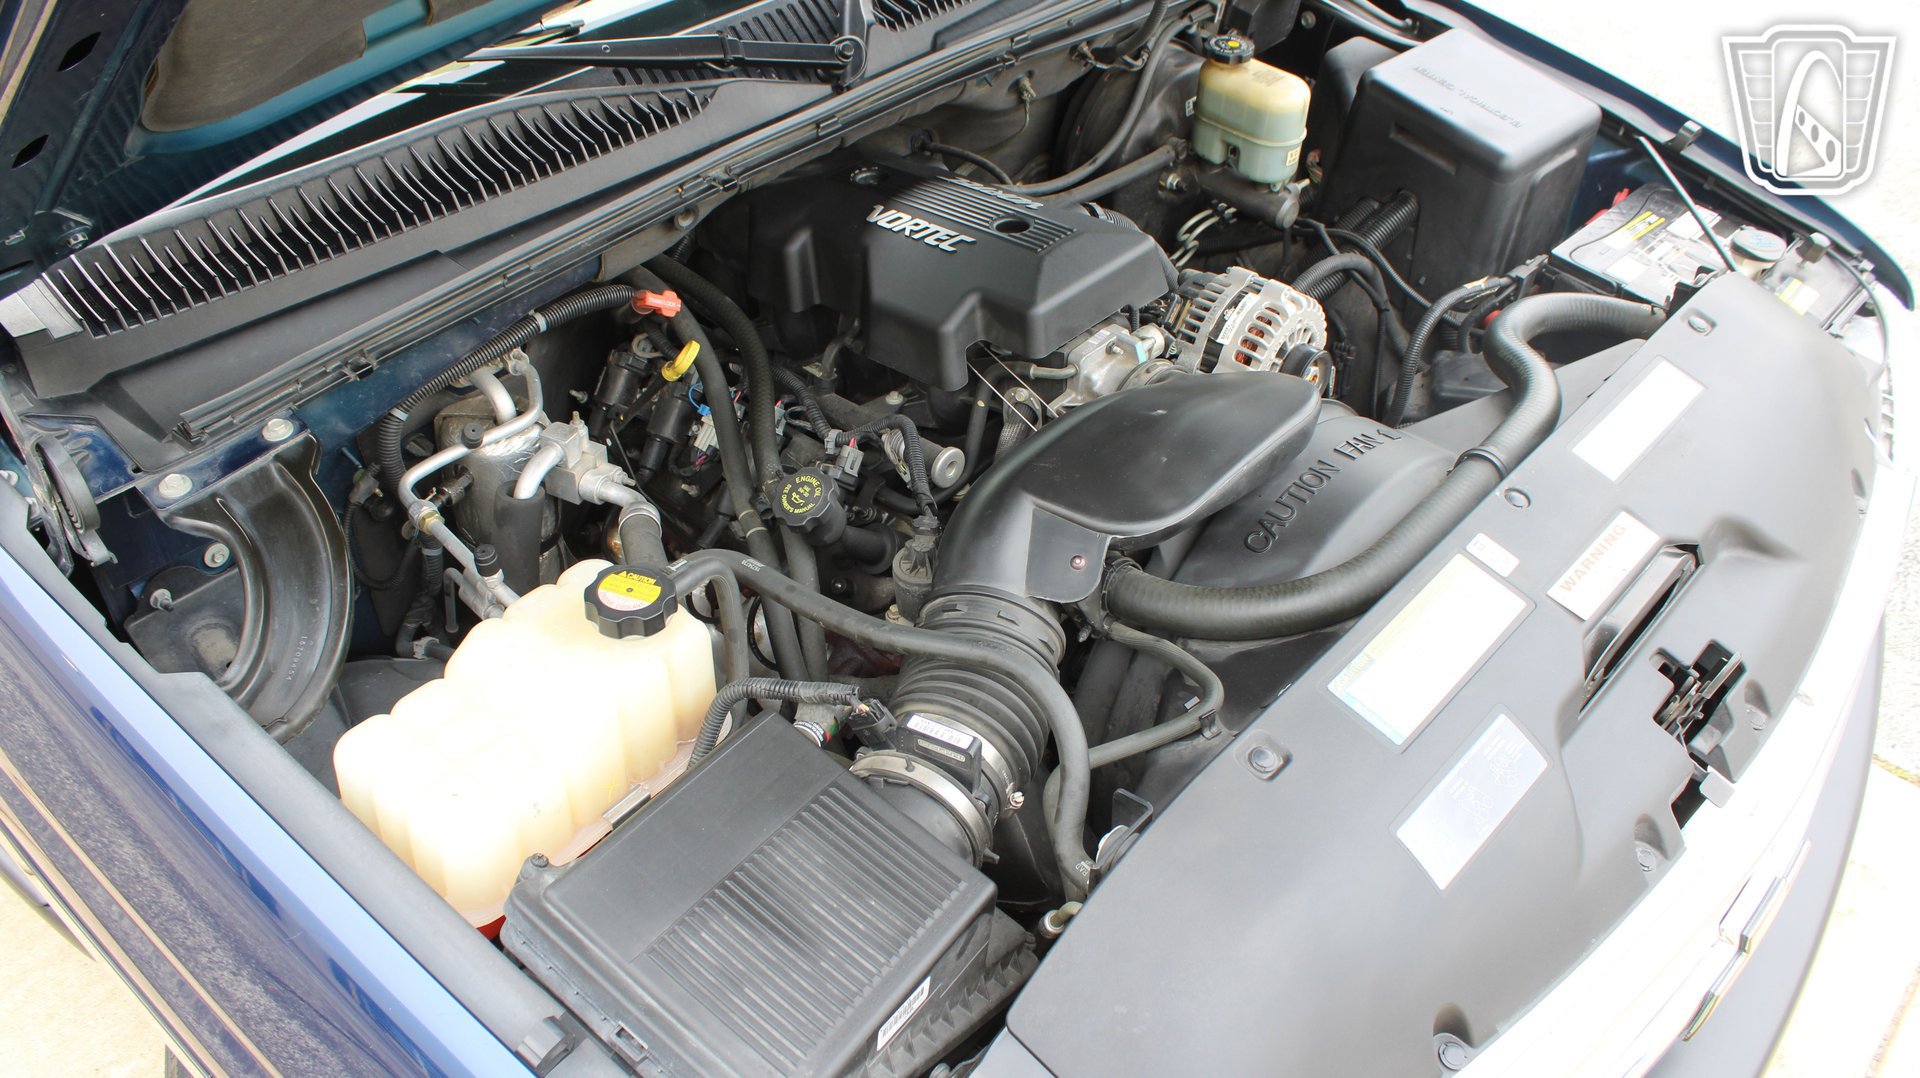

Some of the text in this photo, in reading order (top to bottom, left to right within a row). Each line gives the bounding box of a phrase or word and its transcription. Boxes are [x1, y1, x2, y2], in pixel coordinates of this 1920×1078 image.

[866, 204, 977, 253] VORTEC
[795, 475, 822, 498] ENGINE OIL
[1244, 433, 1385, 554] CAUTION FAN
[793, 502, 816, 514] MANUAL
[1559, 524, 1627, 592] WARNING
[627, 572, 657, 585] CAUTION
